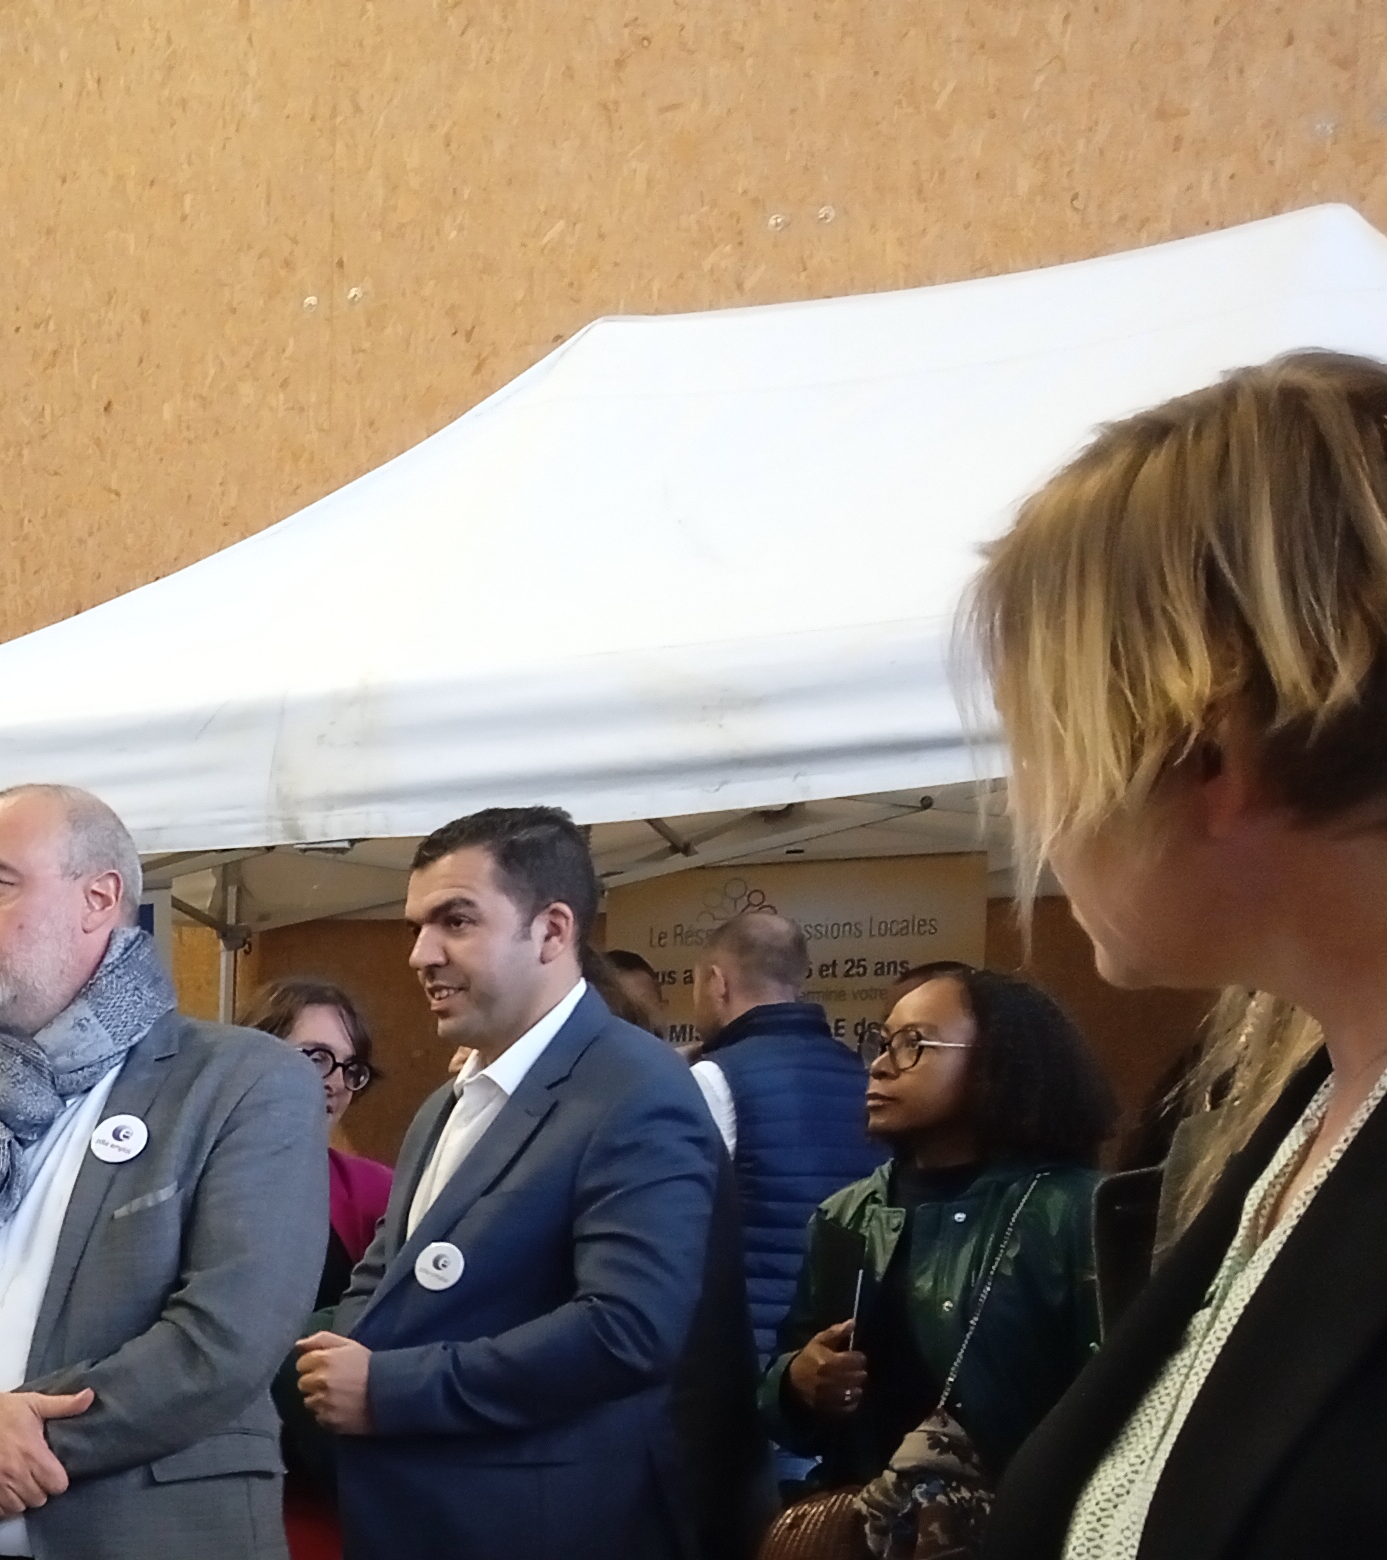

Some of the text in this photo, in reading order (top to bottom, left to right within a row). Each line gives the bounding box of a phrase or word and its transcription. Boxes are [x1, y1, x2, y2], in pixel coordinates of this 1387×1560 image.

[869, 914, 938, 938] Locales
[843, 958, 868, 978] 25
[874, 959, 910, 977] ans
